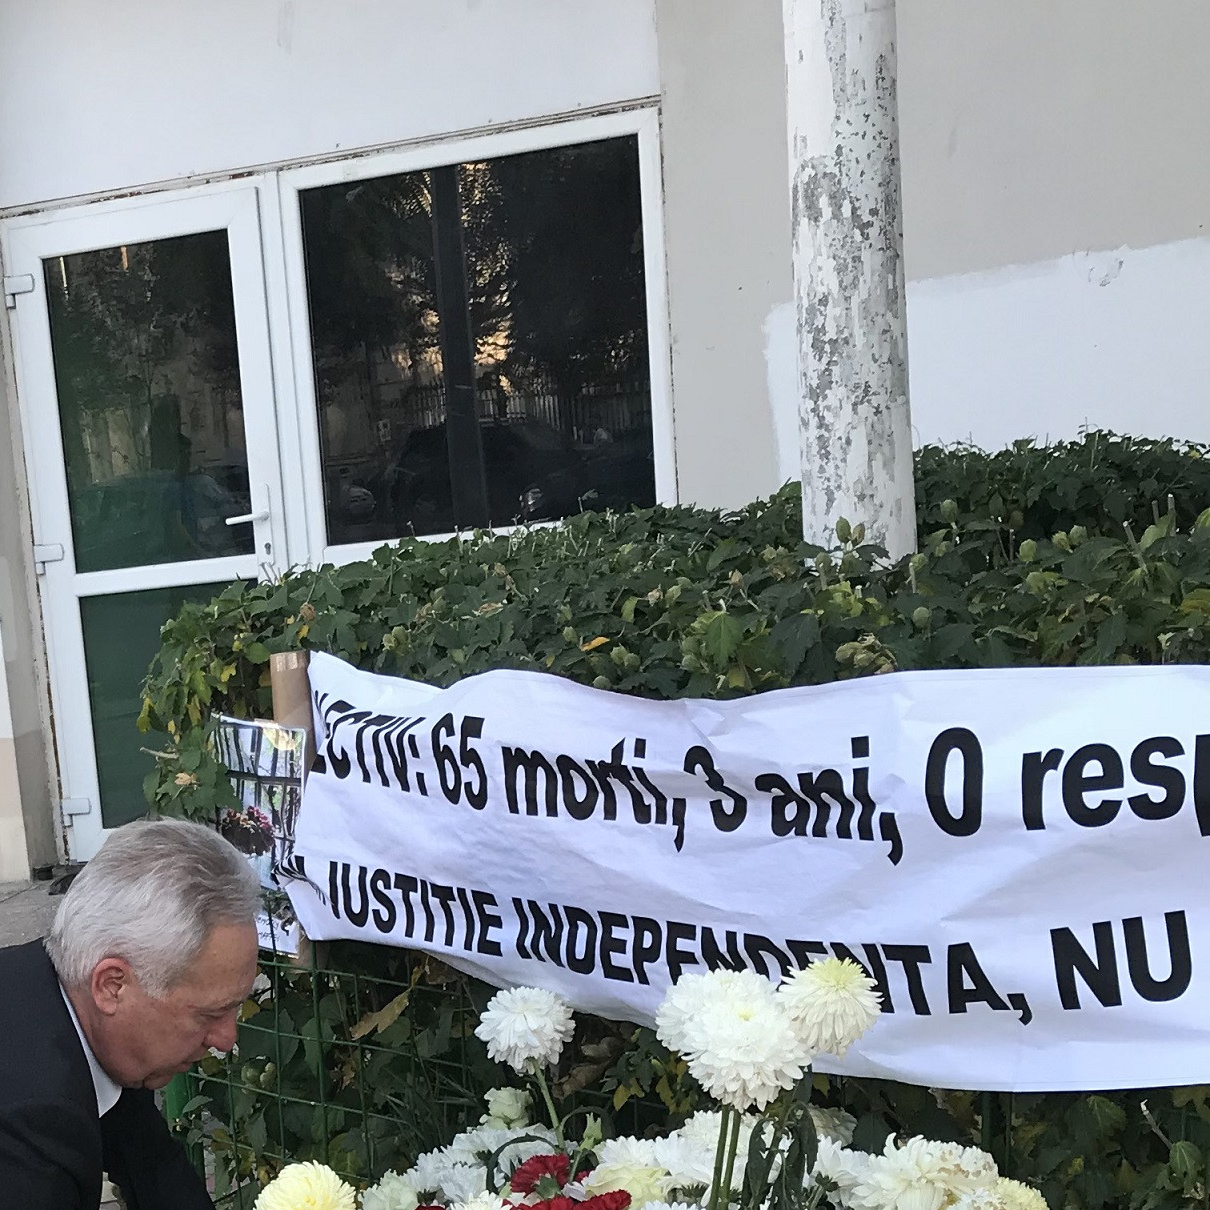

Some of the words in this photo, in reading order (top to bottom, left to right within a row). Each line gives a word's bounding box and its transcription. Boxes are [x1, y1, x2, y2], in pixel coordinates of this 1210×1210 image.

[431, 712, 488, 811] 65
[501, 737, 687, 853] morti,
[683, 745, 748, 832] 3
[755, 735, 903, 867] ani,
[924, 727, 983, 837] 0
[328, 860, 503, 957] IUSTITIE
[1049, 909, 1193, 1010] NU
